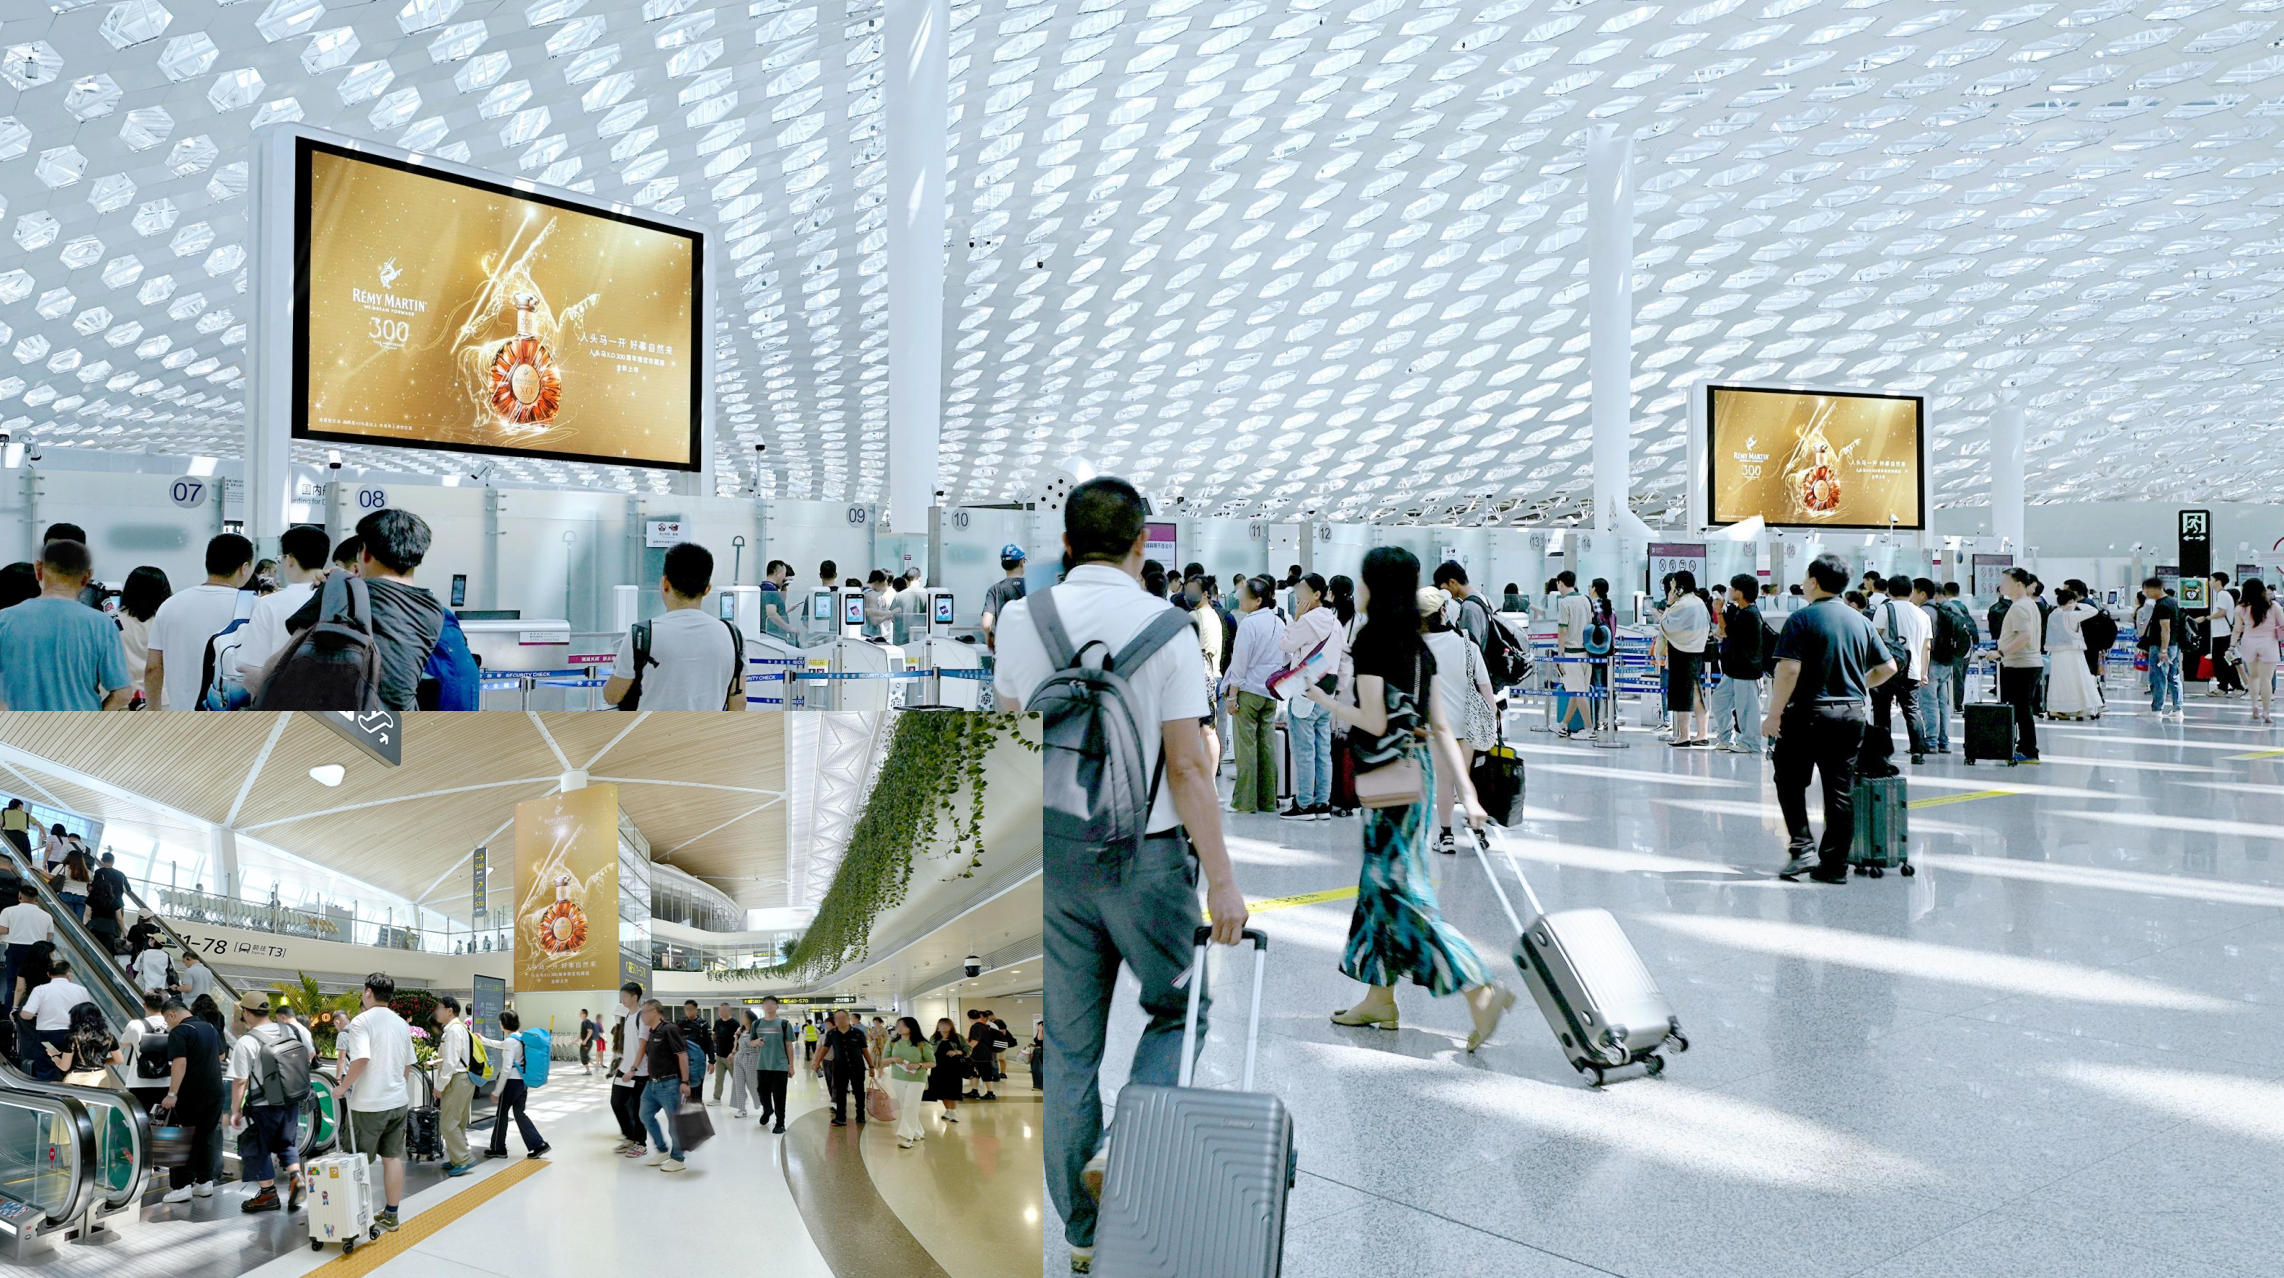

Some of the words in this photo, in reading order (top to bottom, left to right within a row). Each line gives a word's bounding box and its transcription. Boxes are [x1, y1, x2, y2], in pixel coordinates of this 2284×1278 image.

[353, 288, 382, 305] RÉMY
[385, 293, 425, 312] MARTIN
[368, 316, 409, 342] 300
[1742, 465, 1761, 476] 300
[173, 483, 202, 502] 07
[359, 490, 385, 508] 08
[848, 508, 866, 523] 09
[954, 512, 969, 527] 10
[1251, 524, 1261, 537] 11
[1320, 527, 1331, 540] 12
